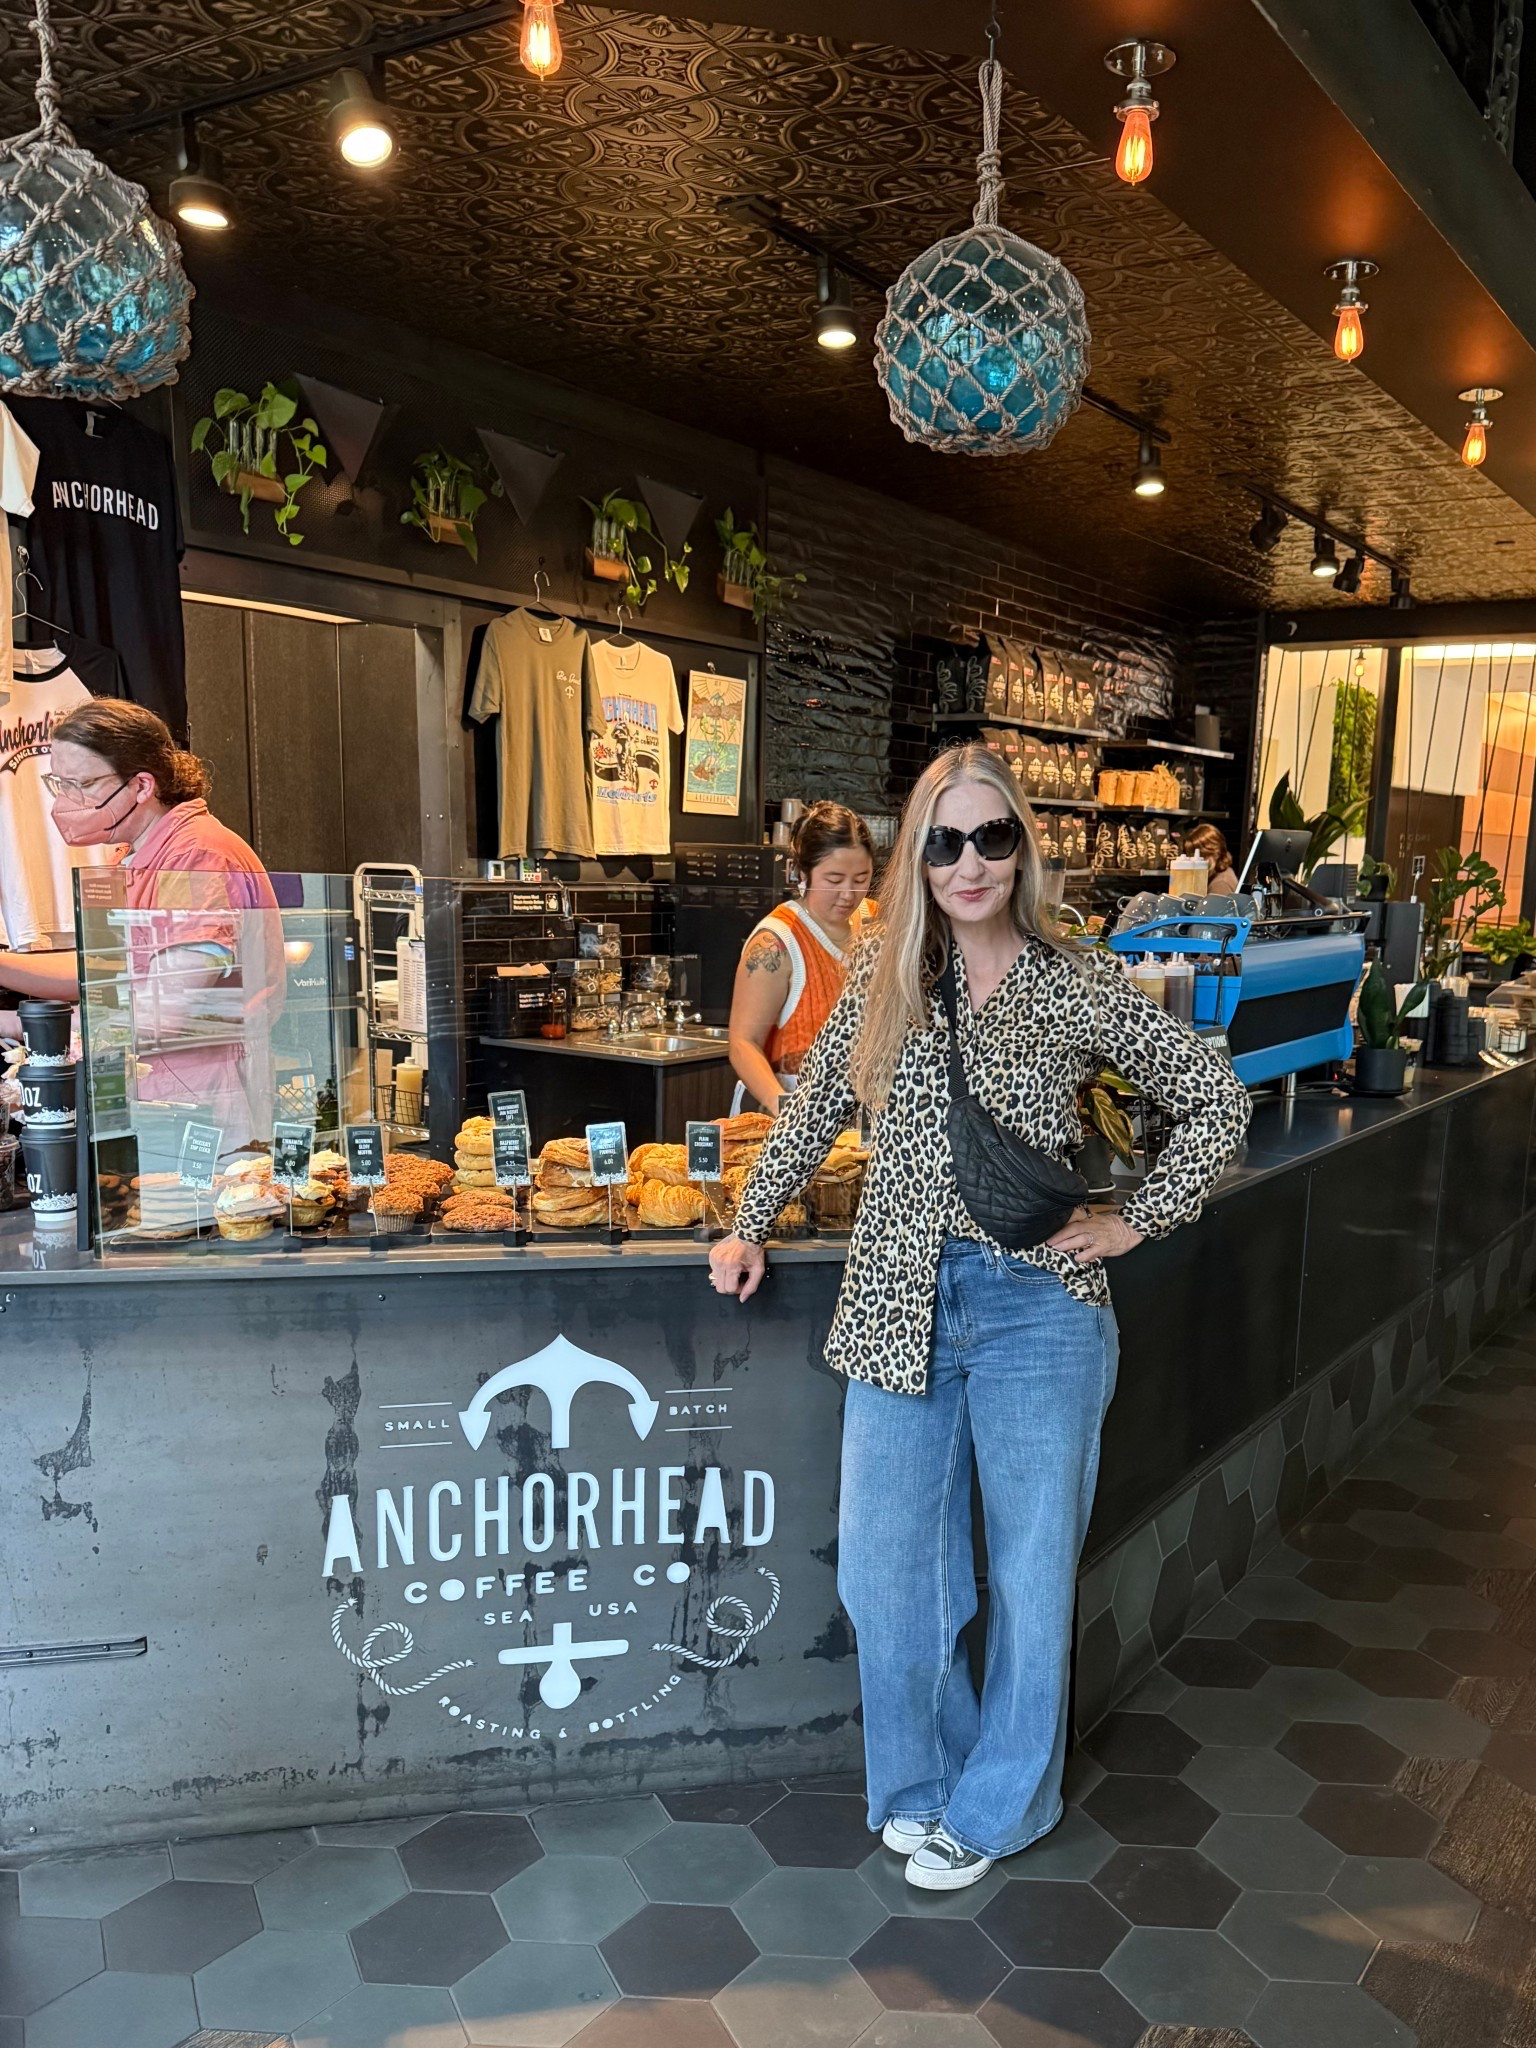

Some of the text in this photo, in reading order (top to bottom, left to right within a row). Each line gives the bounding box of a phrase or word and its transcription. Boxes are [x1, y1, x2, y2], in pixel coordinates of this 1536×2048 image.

[52, 481, 159, 531] ANCHORHEAD
[0, 711, 54, 754] nchorh
[600, 696, 659, 734] CHORHEAD
[8, 746, 39, 770] SINGLE
[1203, 1034, 1228, 1048] PTIONS
[384, 1419, 451, 1432] SMALL
[669, 1403, 729, 1416] BATCH
[321, 1466, 776, 1578] ANCHORHEAD
[404, 1561, 691, 1604] COFFEE CO
[484, 1601, 638, 1626] SEA USA
[438, 1696, 541, 1740] ROASTING
[588, 1674, 682, 1734] BOTTLING
